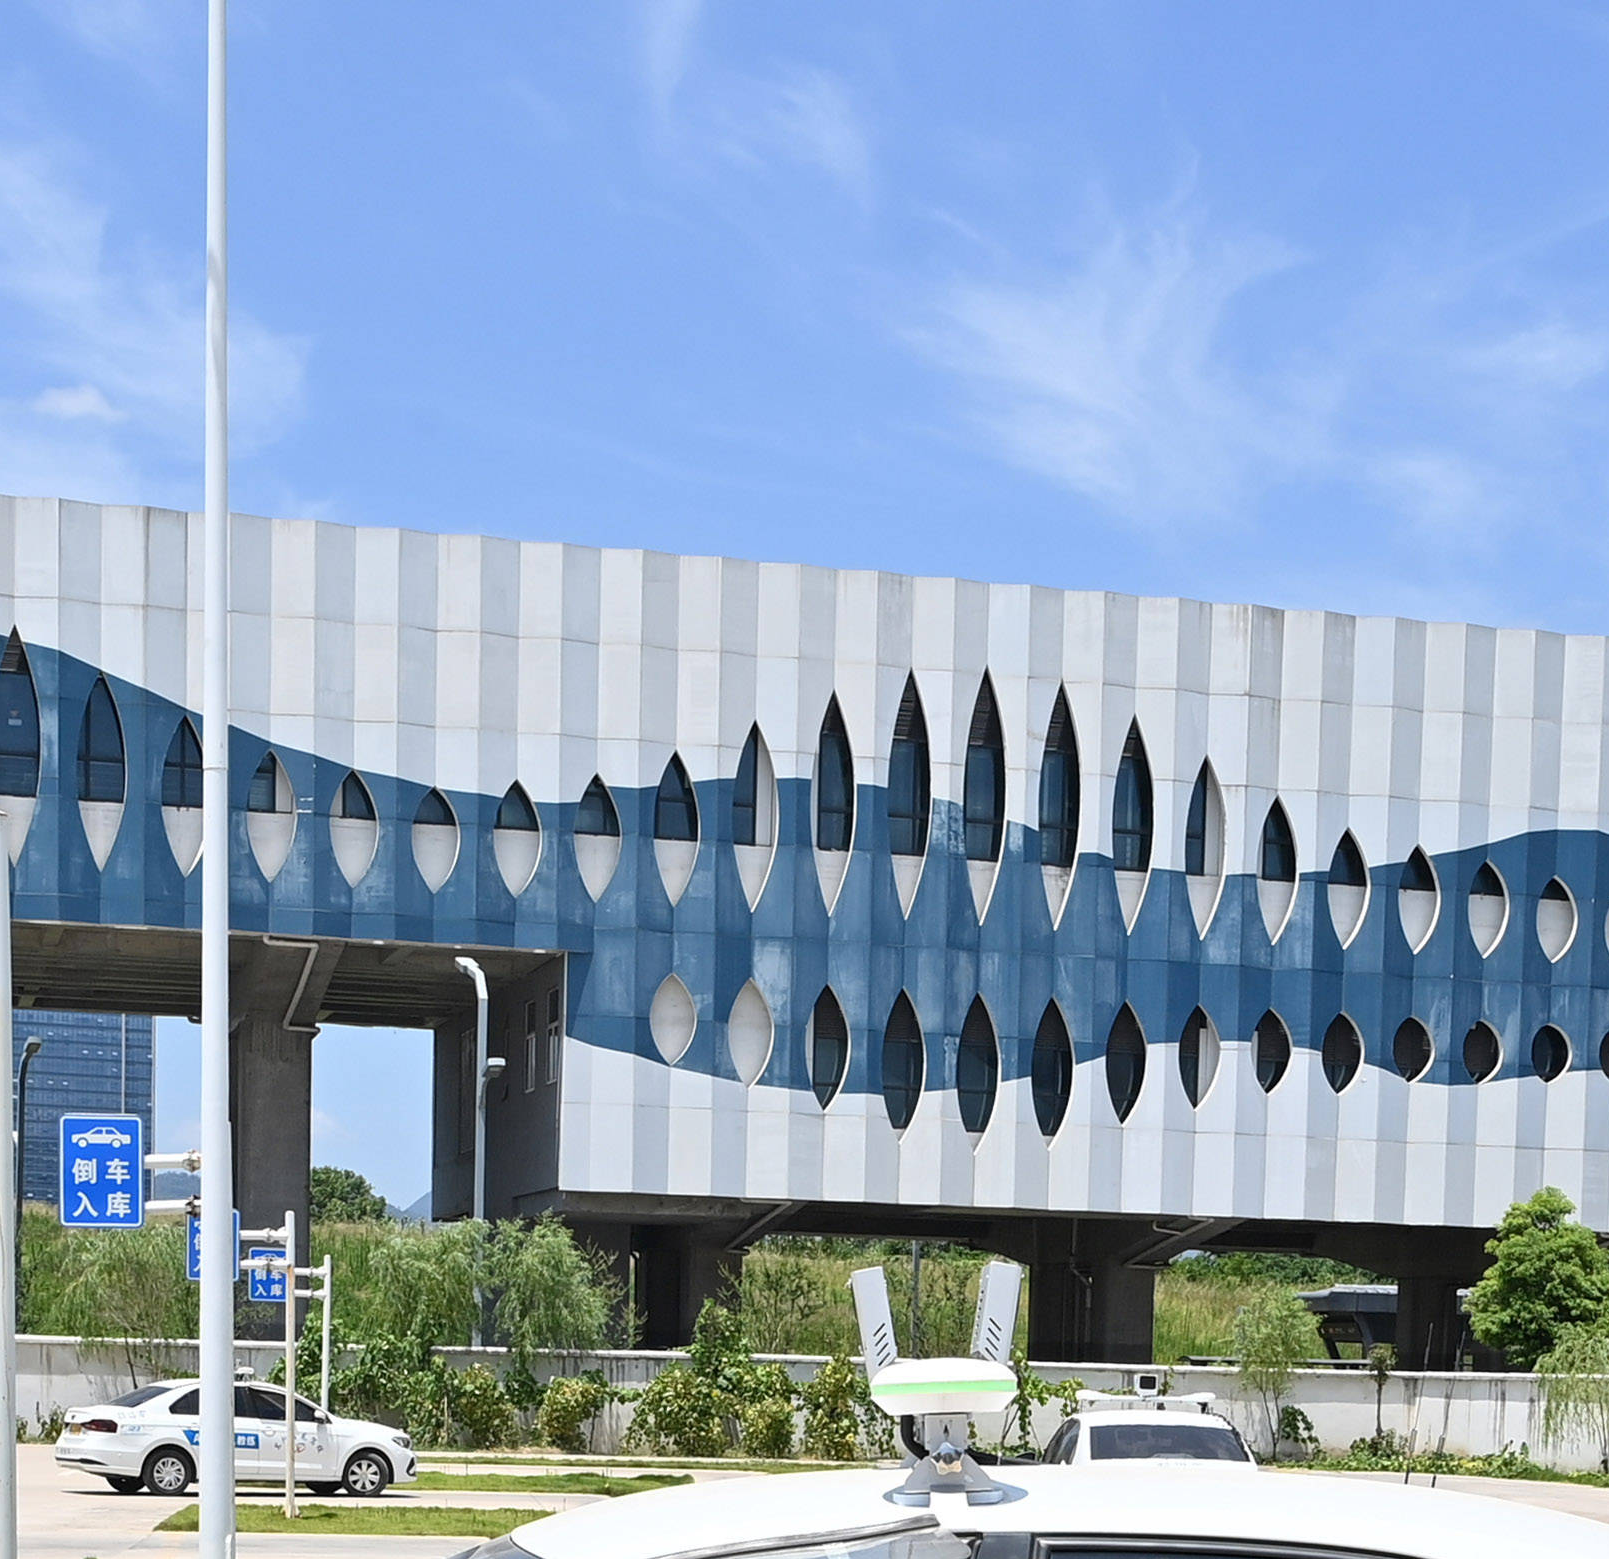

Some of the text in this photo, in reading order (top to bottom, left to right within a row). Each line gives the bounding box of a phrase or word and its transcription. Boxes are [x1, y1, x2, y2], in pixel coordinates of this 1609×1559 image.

[71, 1158, 131, 1186] 倒车
[71, 1191, 131, 1219] 入库
[255, 1284, 283, 1297] 入库
